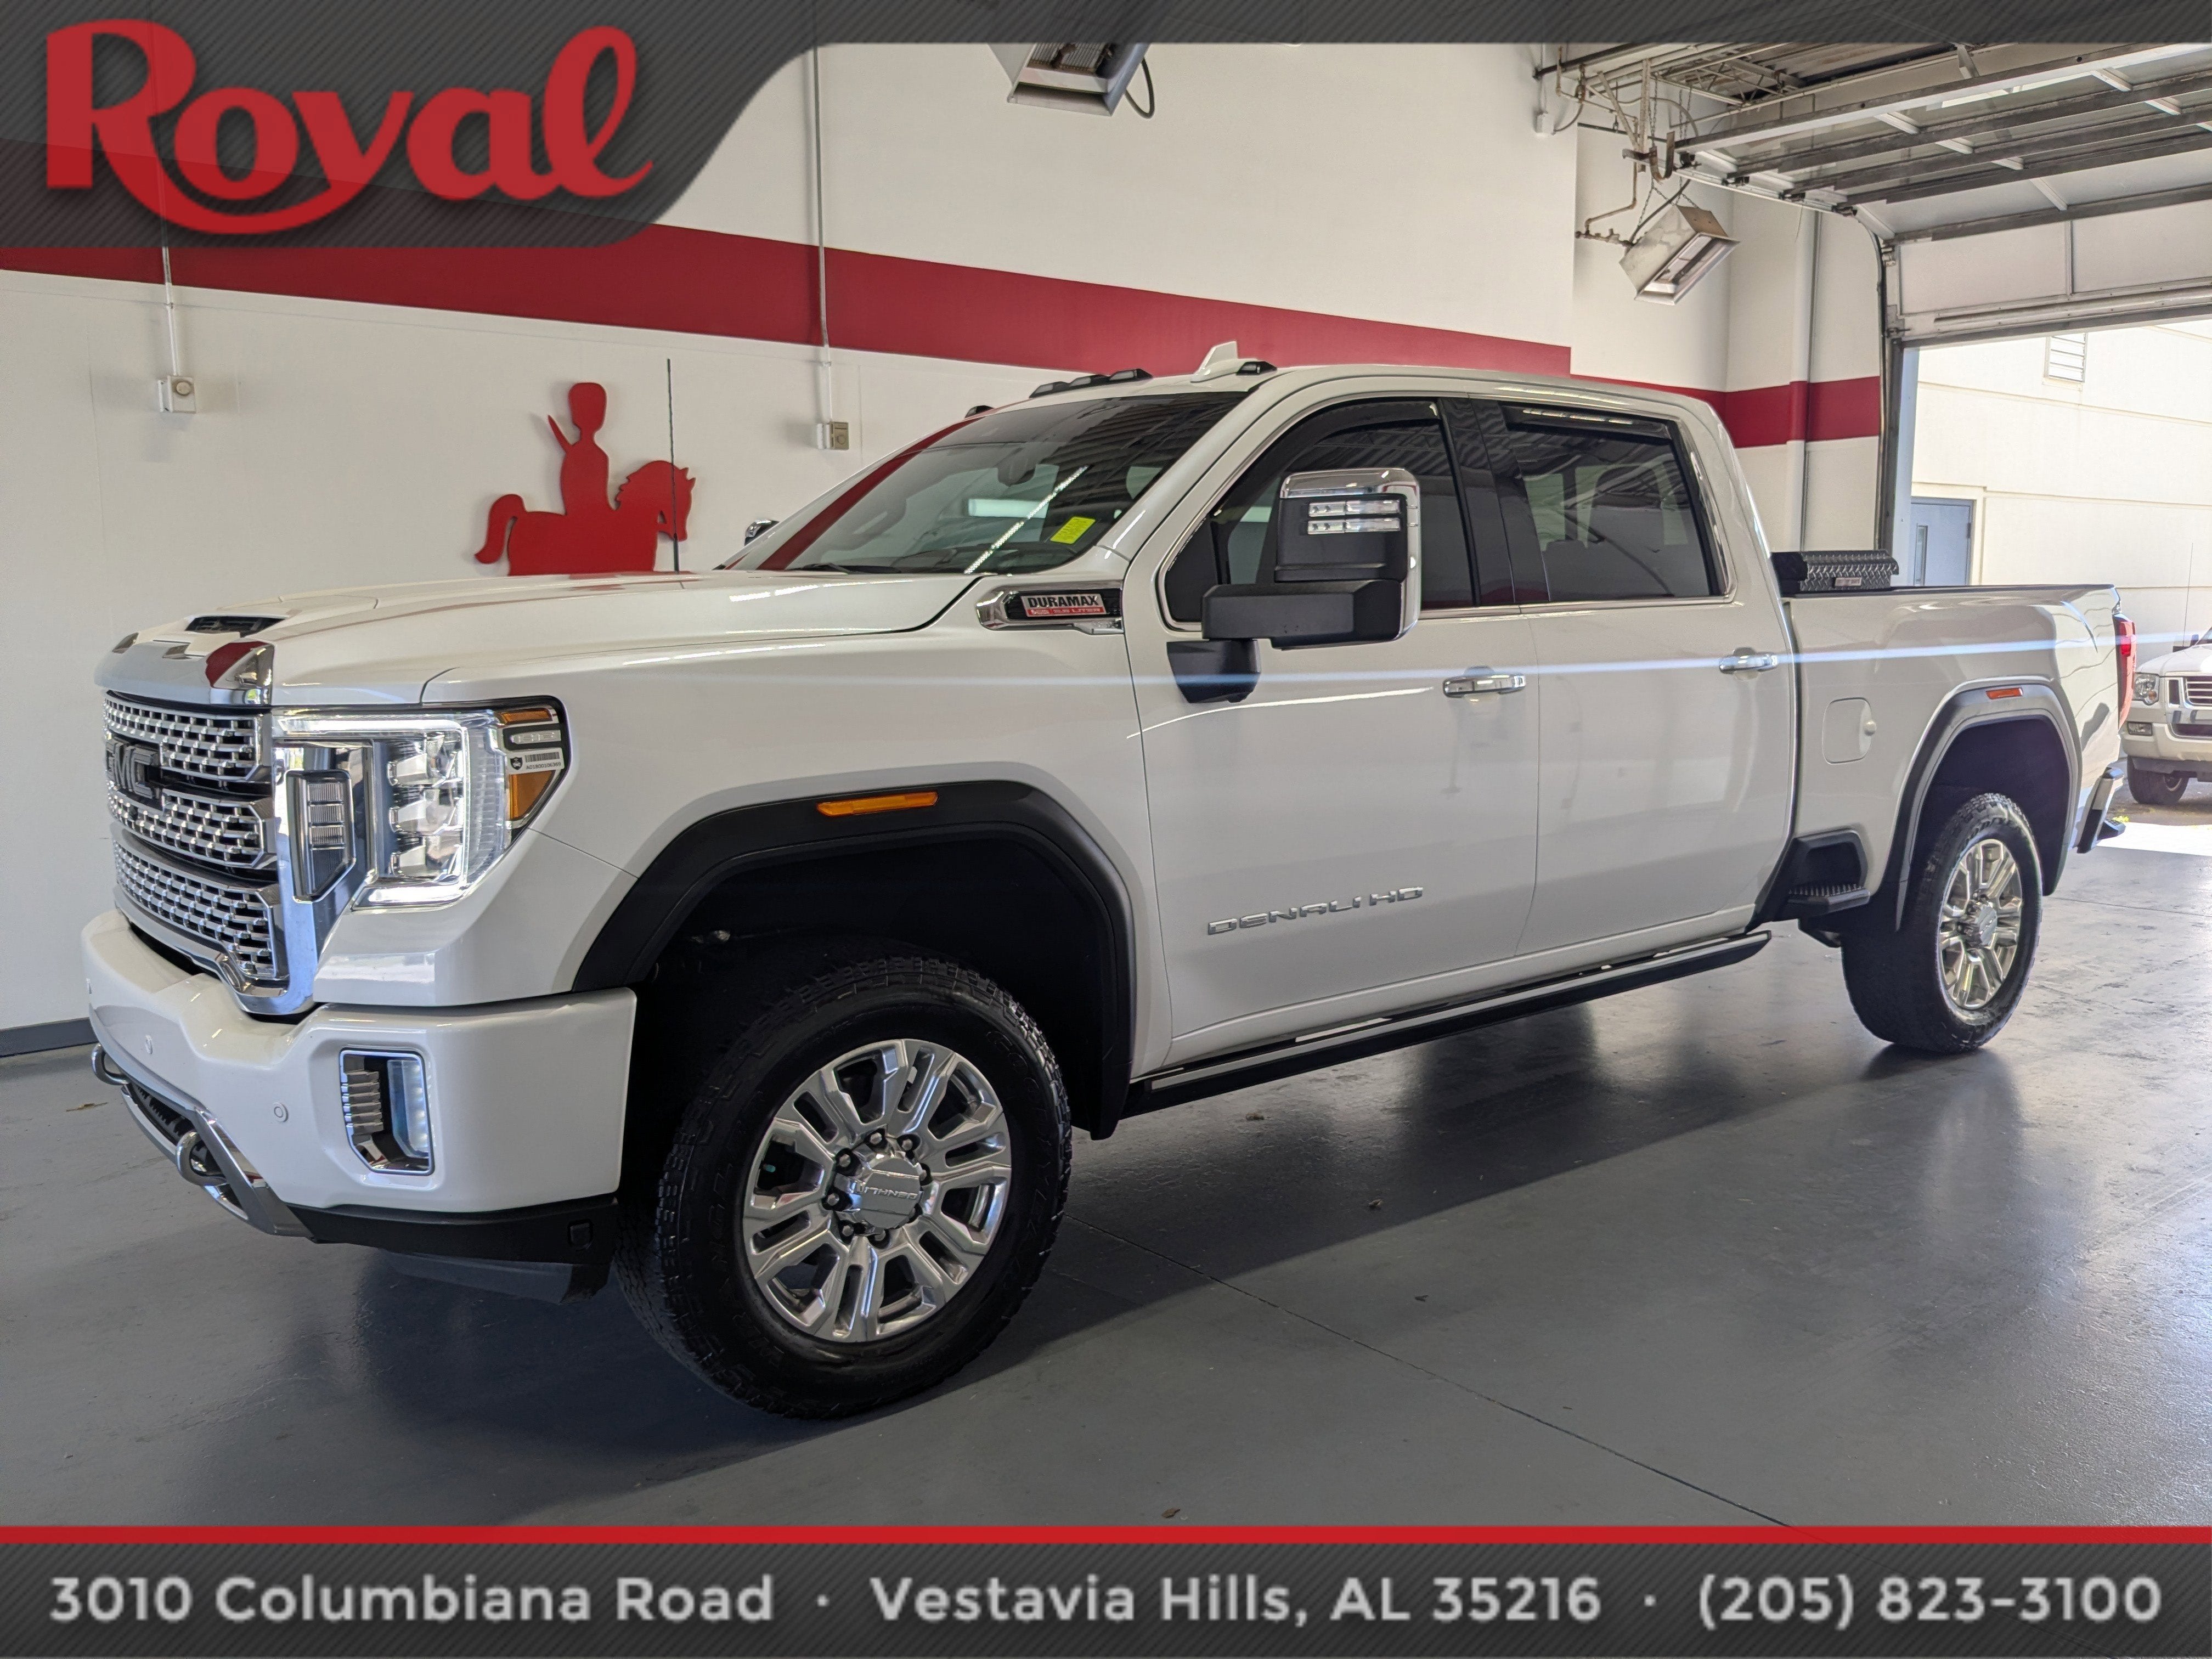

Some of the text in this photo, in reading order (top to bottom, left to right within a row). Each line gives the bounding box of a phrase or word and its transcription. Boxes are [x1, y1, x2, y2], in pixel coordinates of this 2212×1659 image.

[1027, 595, 1099, 608] DURAMAX
[106, 738, 158, 798] GMC
[1207, 886, 1424, 935] DENALI HD
[864, 1186, 918, 1200] DENALI
